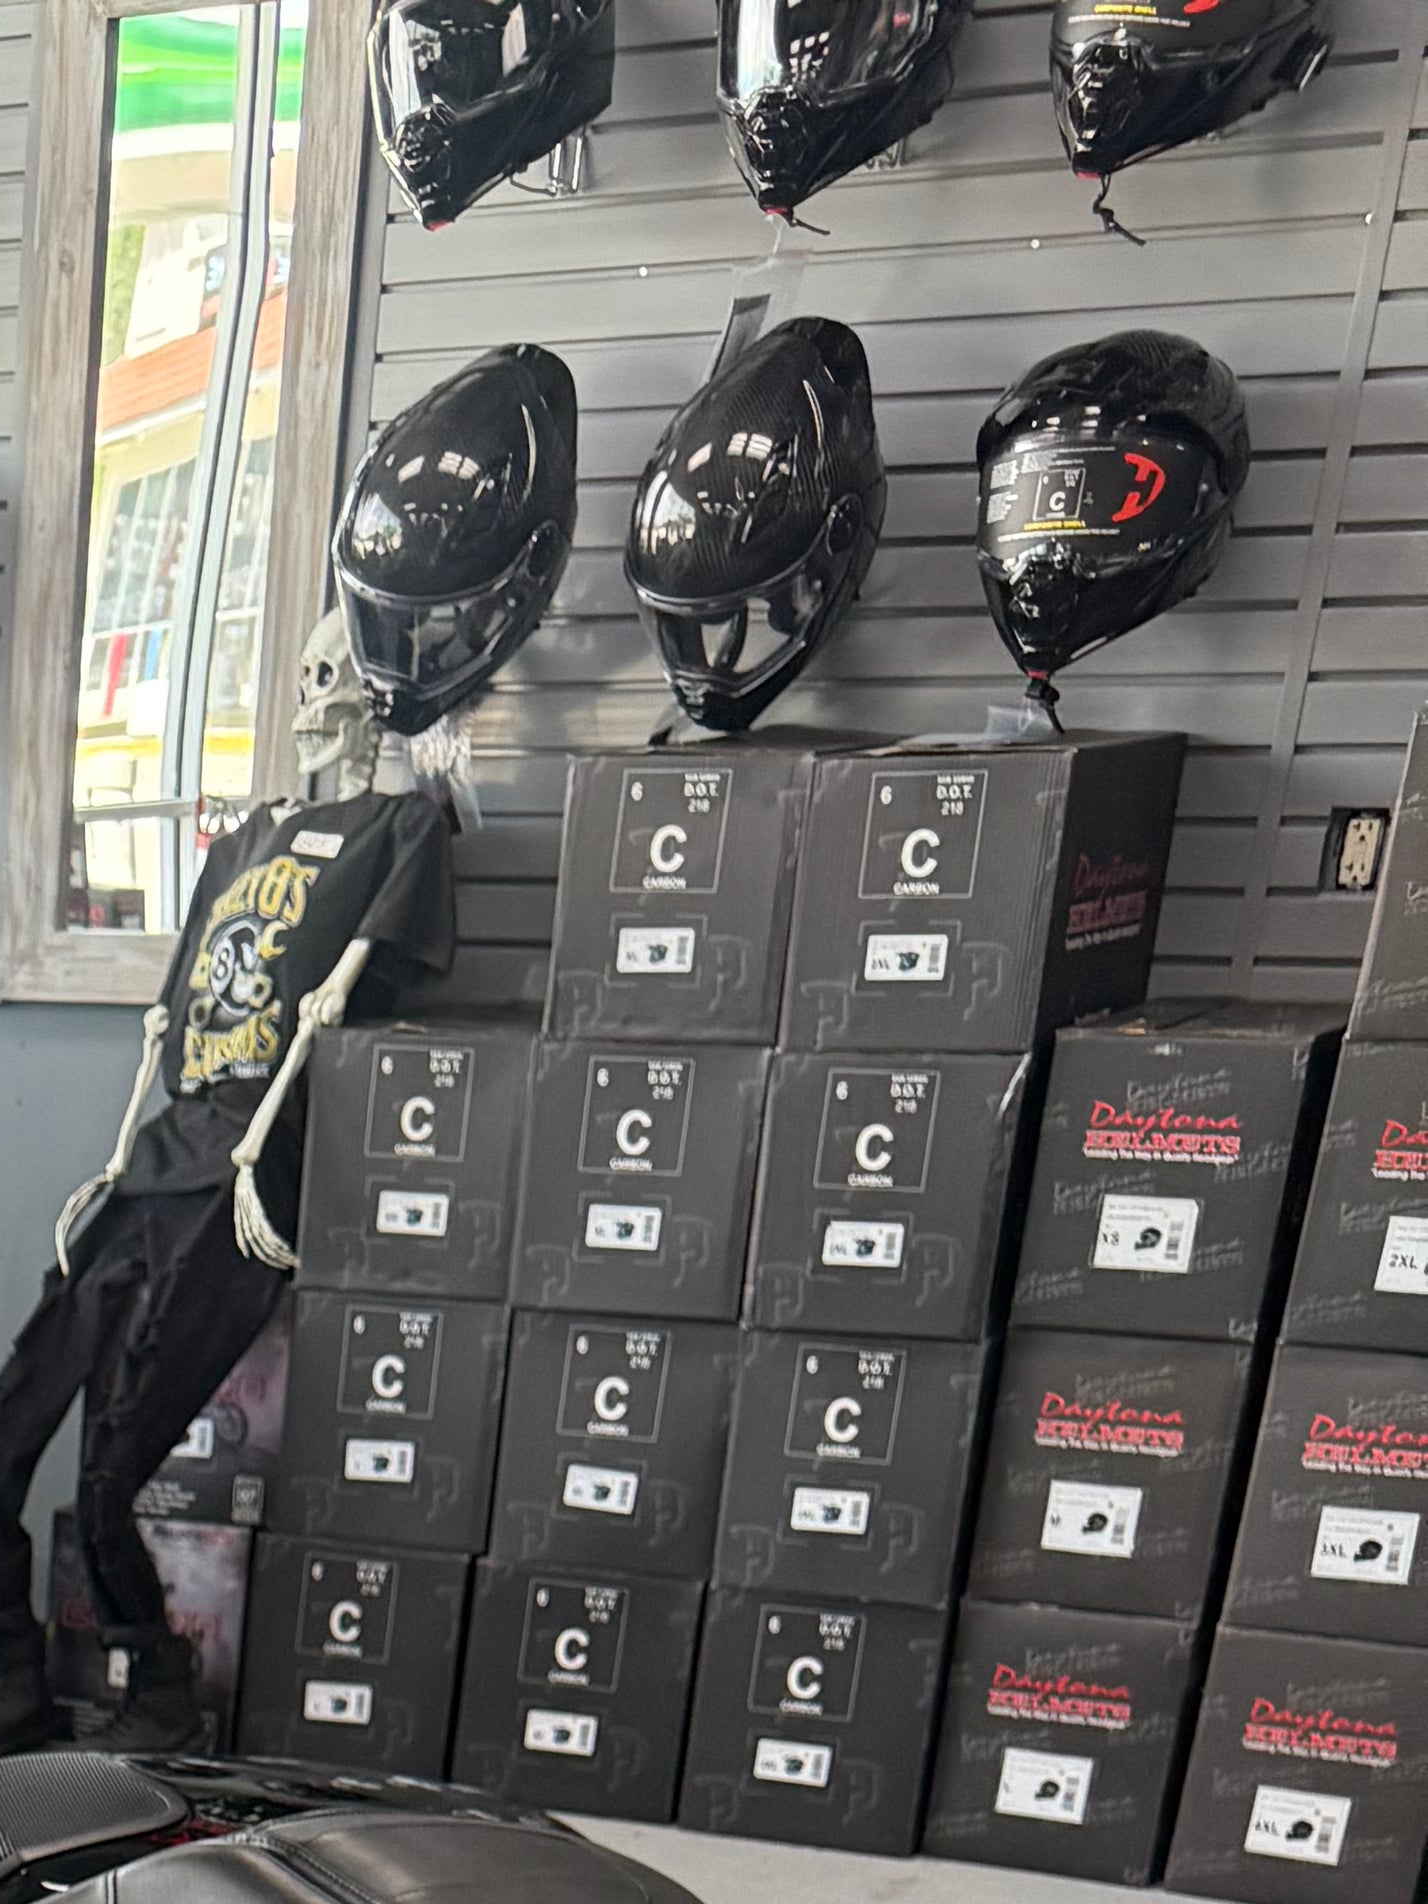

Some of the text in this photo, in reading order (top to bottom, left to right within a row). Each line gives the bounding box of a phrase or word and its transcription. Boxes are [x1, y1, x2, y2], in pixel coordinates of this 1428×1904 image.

[1049, 491, 1065, 511] C
[880, 786, 892, 804] 6
[650, 824, 687, 872] C
[901, 829, 940, 878] C
[893, 882, 939, 895] CARBON
[401, 1096, 435, 1141] C
[616, 1109, 652, 1155] C
[1090, 1100, 1242, 1136] Daytona
[856, 1123, 894, 1171] C
[1084, 1130, 1240, 1154] HELMETS
[1389, 1253, 1417, 1270] 2XL
[372, 1355, 405, 1398] C
[595, 1376, 629, 1420] C
[1040, 1392, 1184, 1426] Daytona
[824, 1397, 861, 1443] C
[1036, 1418, 1184, 1450] HELMETS
[329, 1601, 362, 1642] C
[555, 1627, 590, 1670] C
[787, 1656, 823, 1699] C
[992, 1664, 1130, 1699] Daytona
[987, 1688, 1130, 1722] HELMETS
[1250, 1697, 1396, 1736] Daytona
[1245, 1722, 1396, 1760] HELMETS
